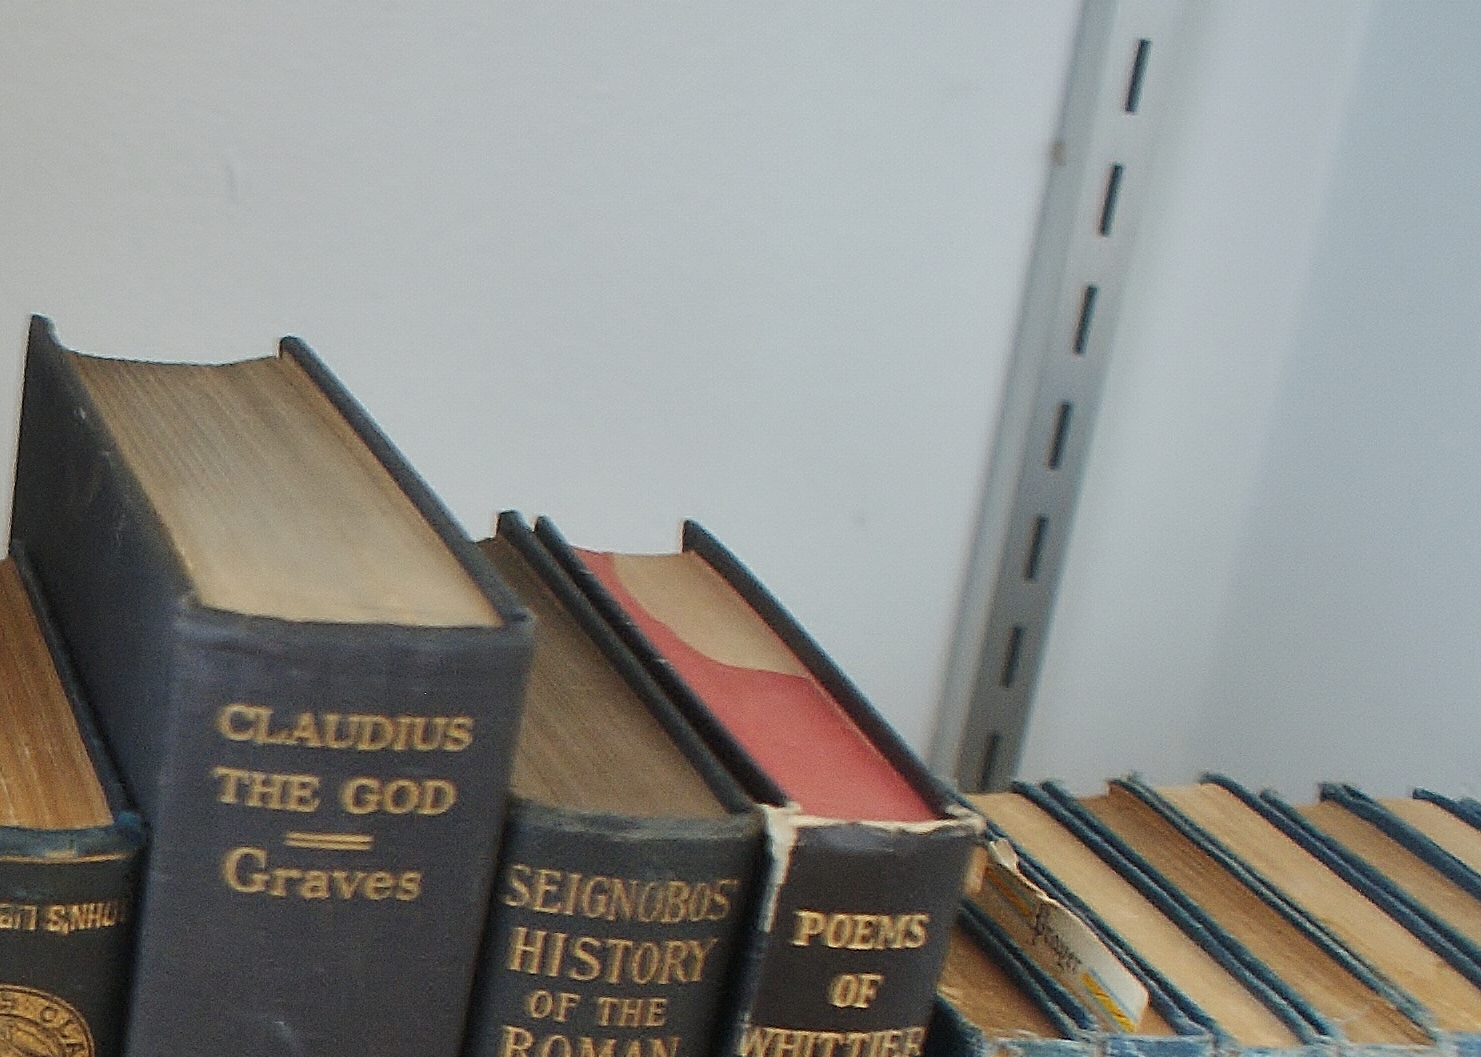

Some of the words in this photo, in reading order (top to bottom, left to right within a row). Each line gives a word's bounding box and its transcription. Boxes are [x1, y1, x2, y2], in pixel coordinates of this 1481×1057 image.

[217, 703, 475, 752] CLAUDIUS
[212, 765, 321, 813] THE
[340, 776, 458, 815] GOD
[223, 846, 423, 901] Graves
[789, 909, 930, 950] POEMS
[507, 927, 719, 985] HISTORY
[528, 989, 581, 1022] OF
[597, 996, 668, 1028] THE
[829, 972, 884, 1009] OF
